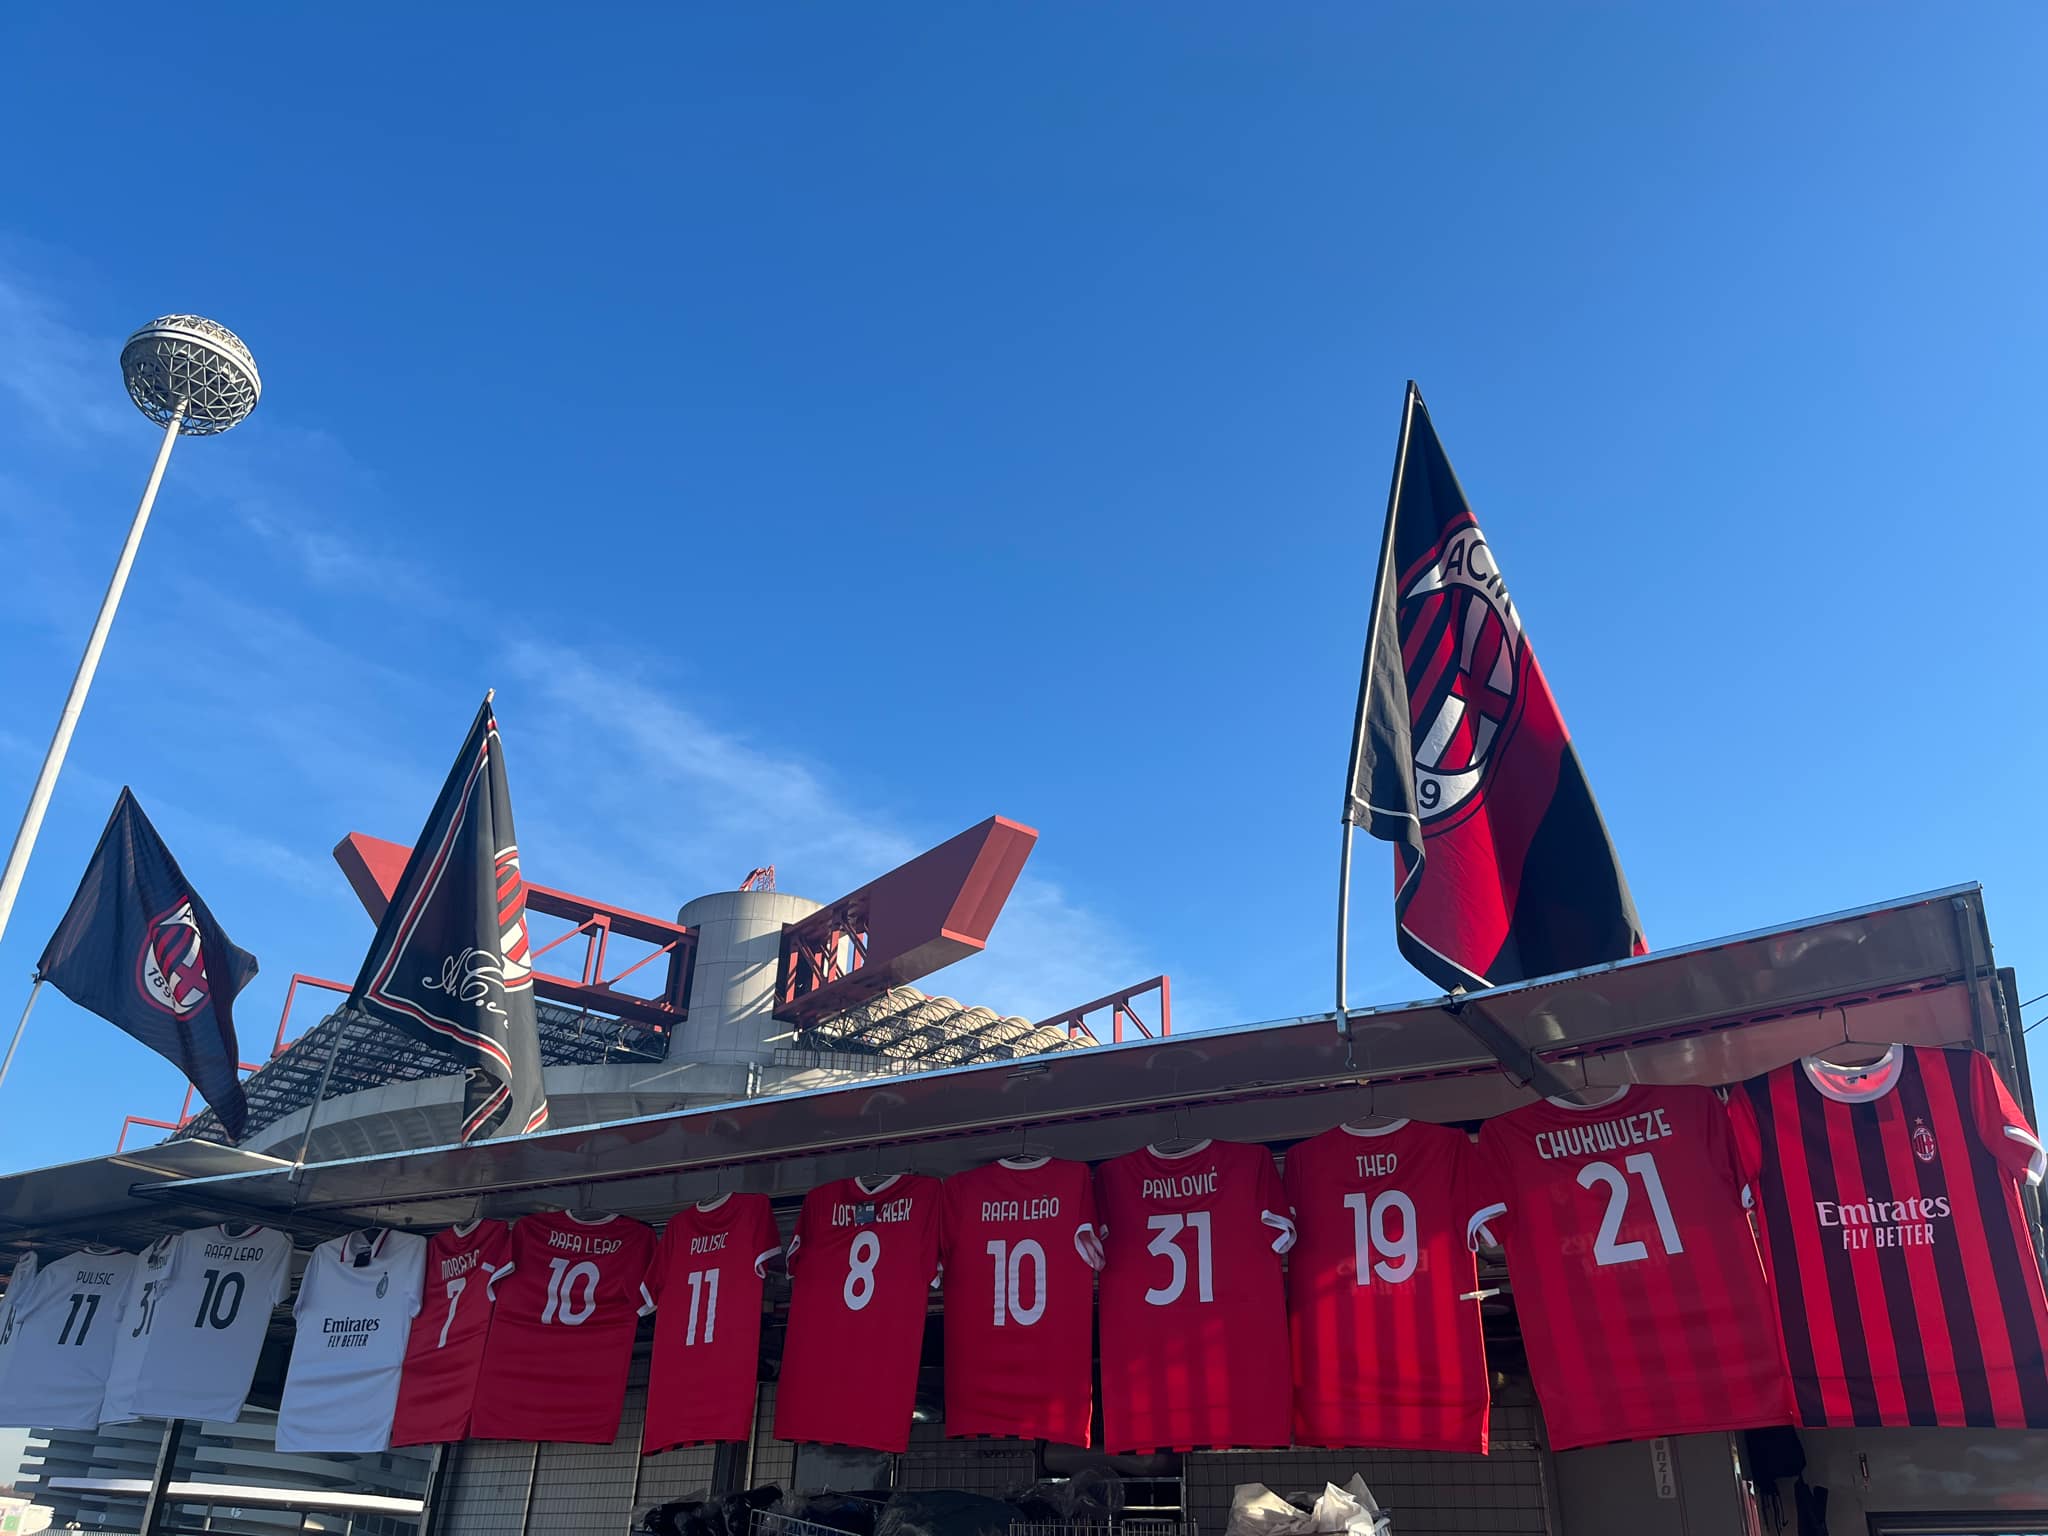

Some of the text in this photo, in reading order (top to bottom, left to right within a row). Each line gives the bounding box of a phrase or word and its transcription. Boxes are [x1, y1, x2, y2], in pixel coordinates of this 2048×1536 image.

[1535, 1108, 1673, 1160] CHUKWUEZE
[1142, 1166, 1218, 1199] PAVLOVIĆ
[1356, 1153, 1398, 1178] THEO
[981, 1201, 1019, 1222] RAFA
[1576, 1152, 1684, 1266] 21
[1815, 1196, 1951, 1227] Emirates
[204, 1243, 233, 1260] RAFA
[548, 1230, 582, 1254] RAFA
[690, 1232, 728, 1256] PULISIC
[1343, 1189, 1419, 1286] 19
[1842, 1223, 1935, 1250] FLY BETTER
[75, 1271, 115, 1285] PULISIC
[843, 1230, 881, 1311] 8
[1145, 1211, 1214, 1306] 31
[194, 1269, 246, 1330] 10
[541, 1257, 600, 1326] 10
[986, 1239, 1047, 1326] 10
[58, 1293, 102, 1346] 11
[323, 1317, 381, 1333] Emirates
[437, 1277, 466, 1348] 7
[686, 1268, 720, 1346] 11
[327, 1333, 369, 1348] FLY BETTER
